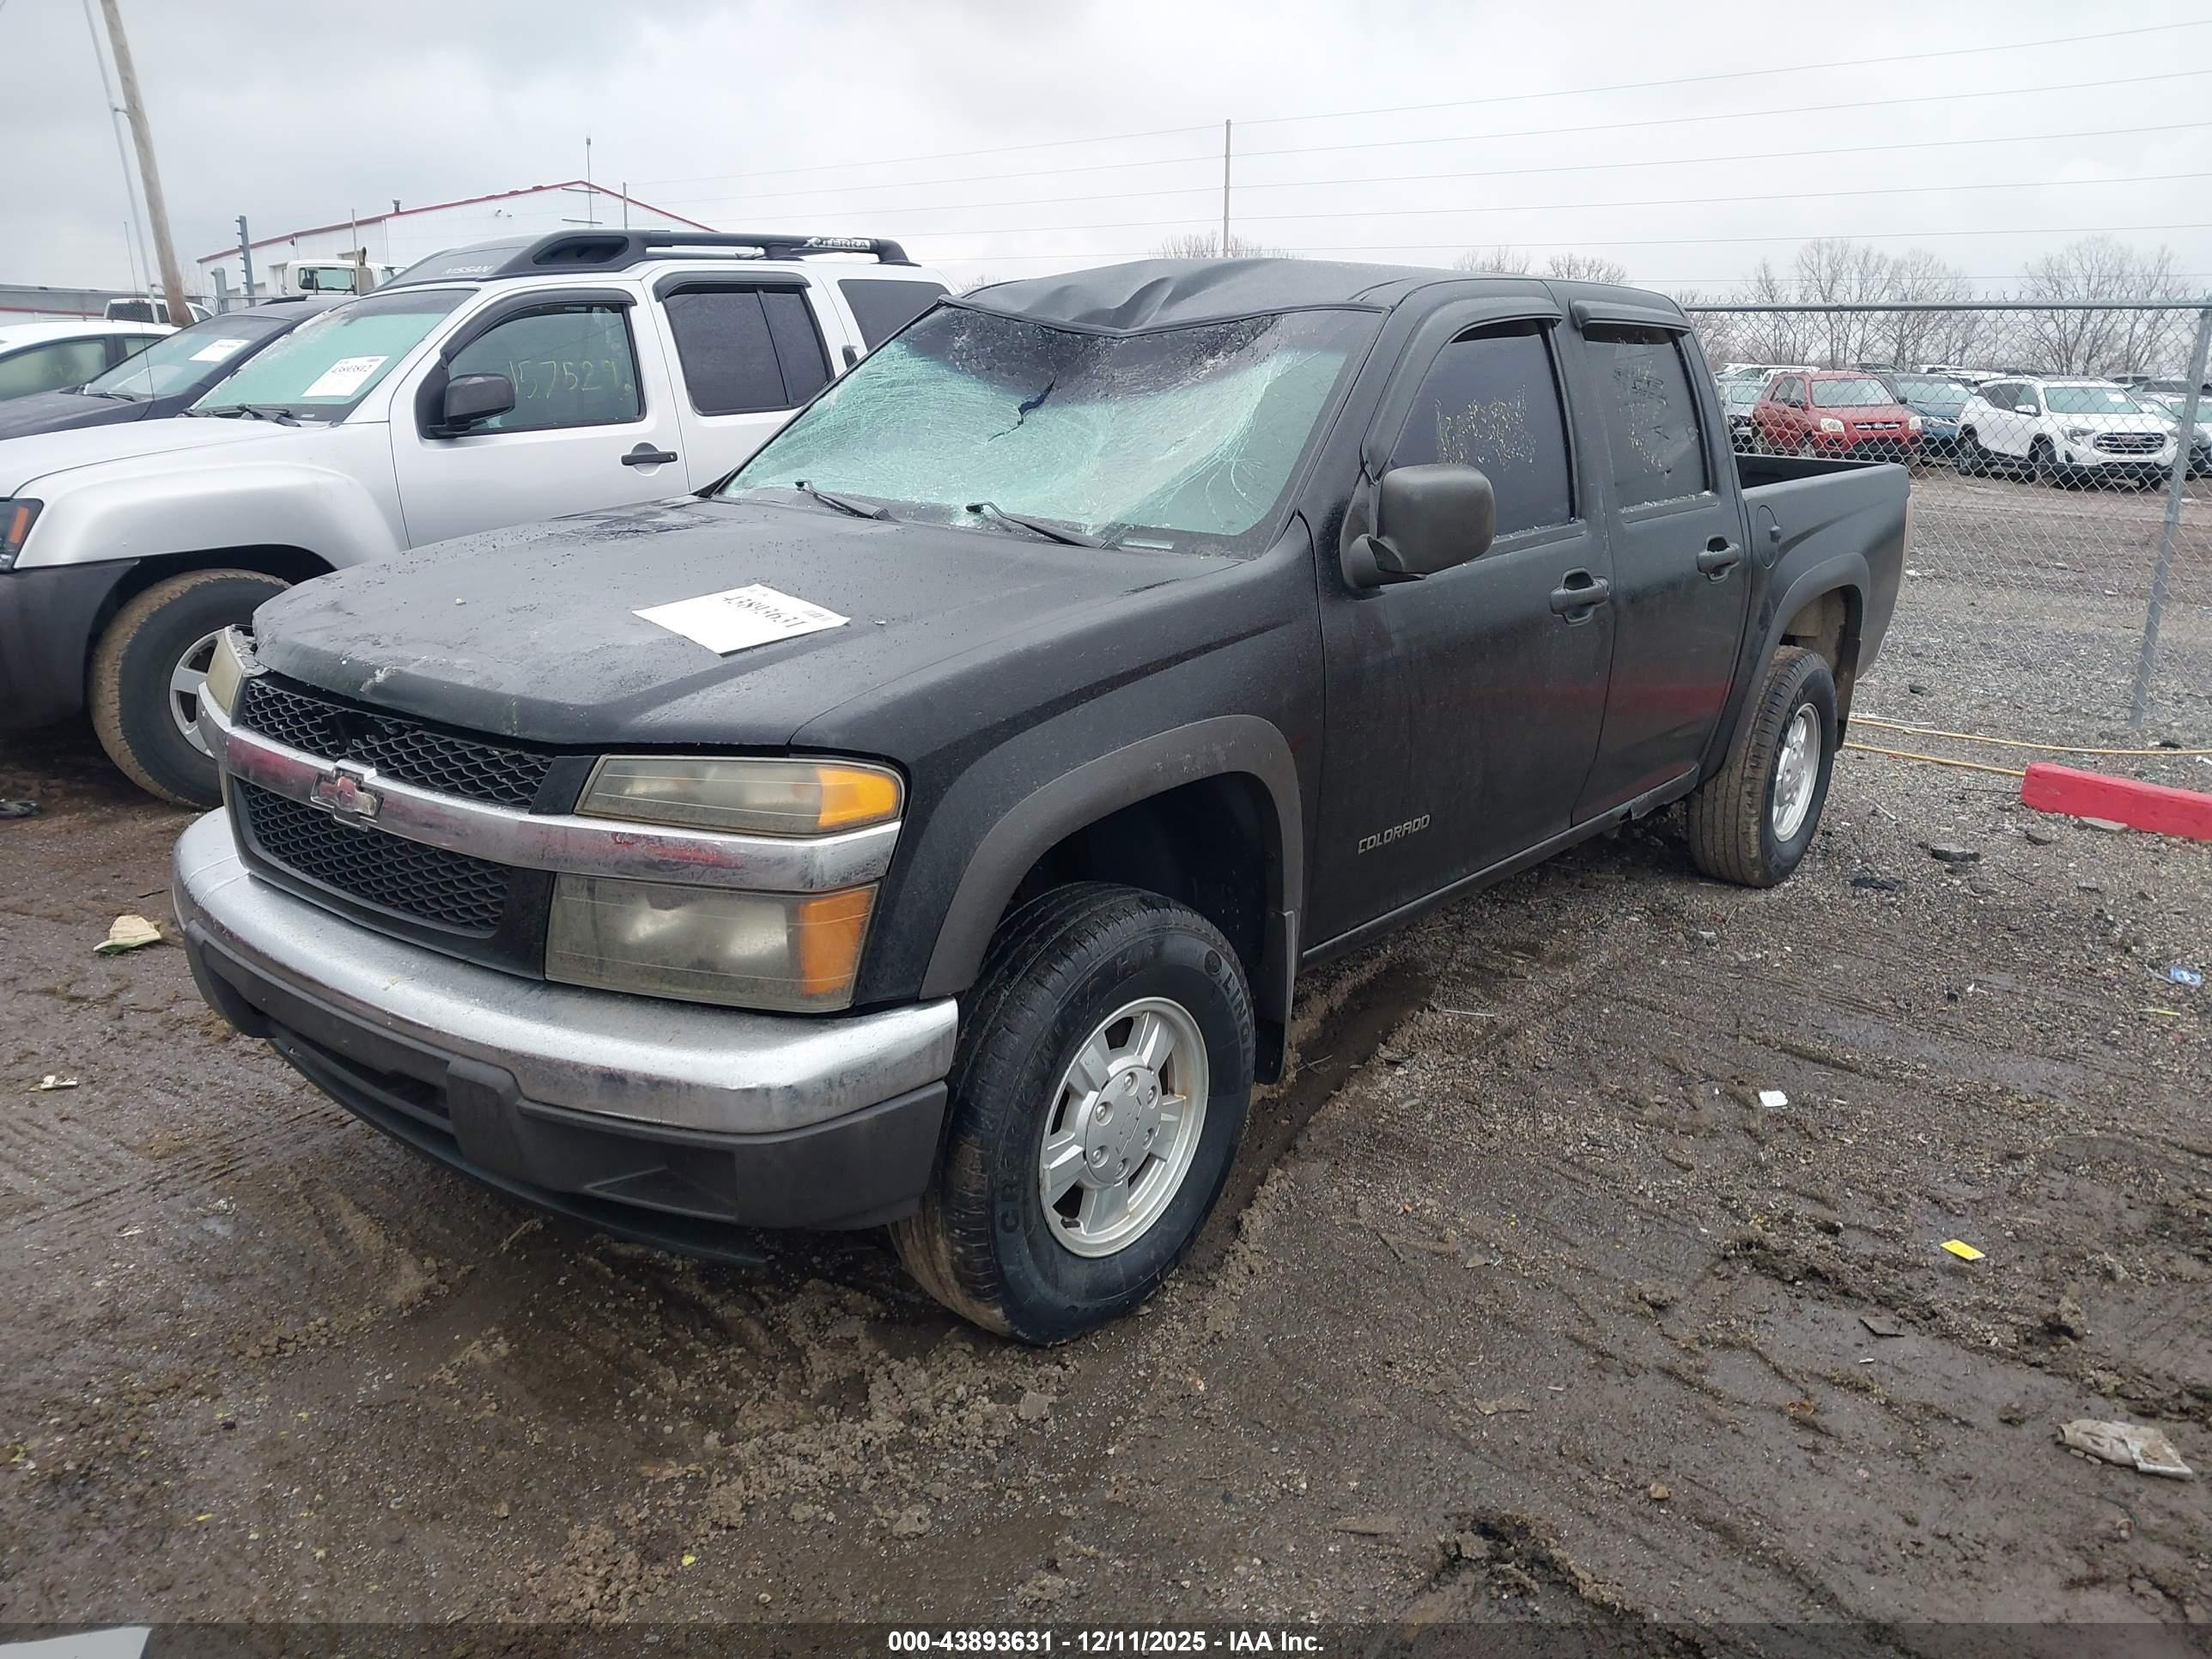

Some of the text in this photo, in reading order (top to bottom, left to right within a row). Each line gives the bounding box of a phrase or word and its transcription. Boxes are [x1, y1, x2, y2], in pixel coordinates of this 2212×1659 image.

[803, 236, 869, 249] XTERRA
[722, 595, 807, 628] 43893631
[1358, 814, 1431, 855] COLORADO
